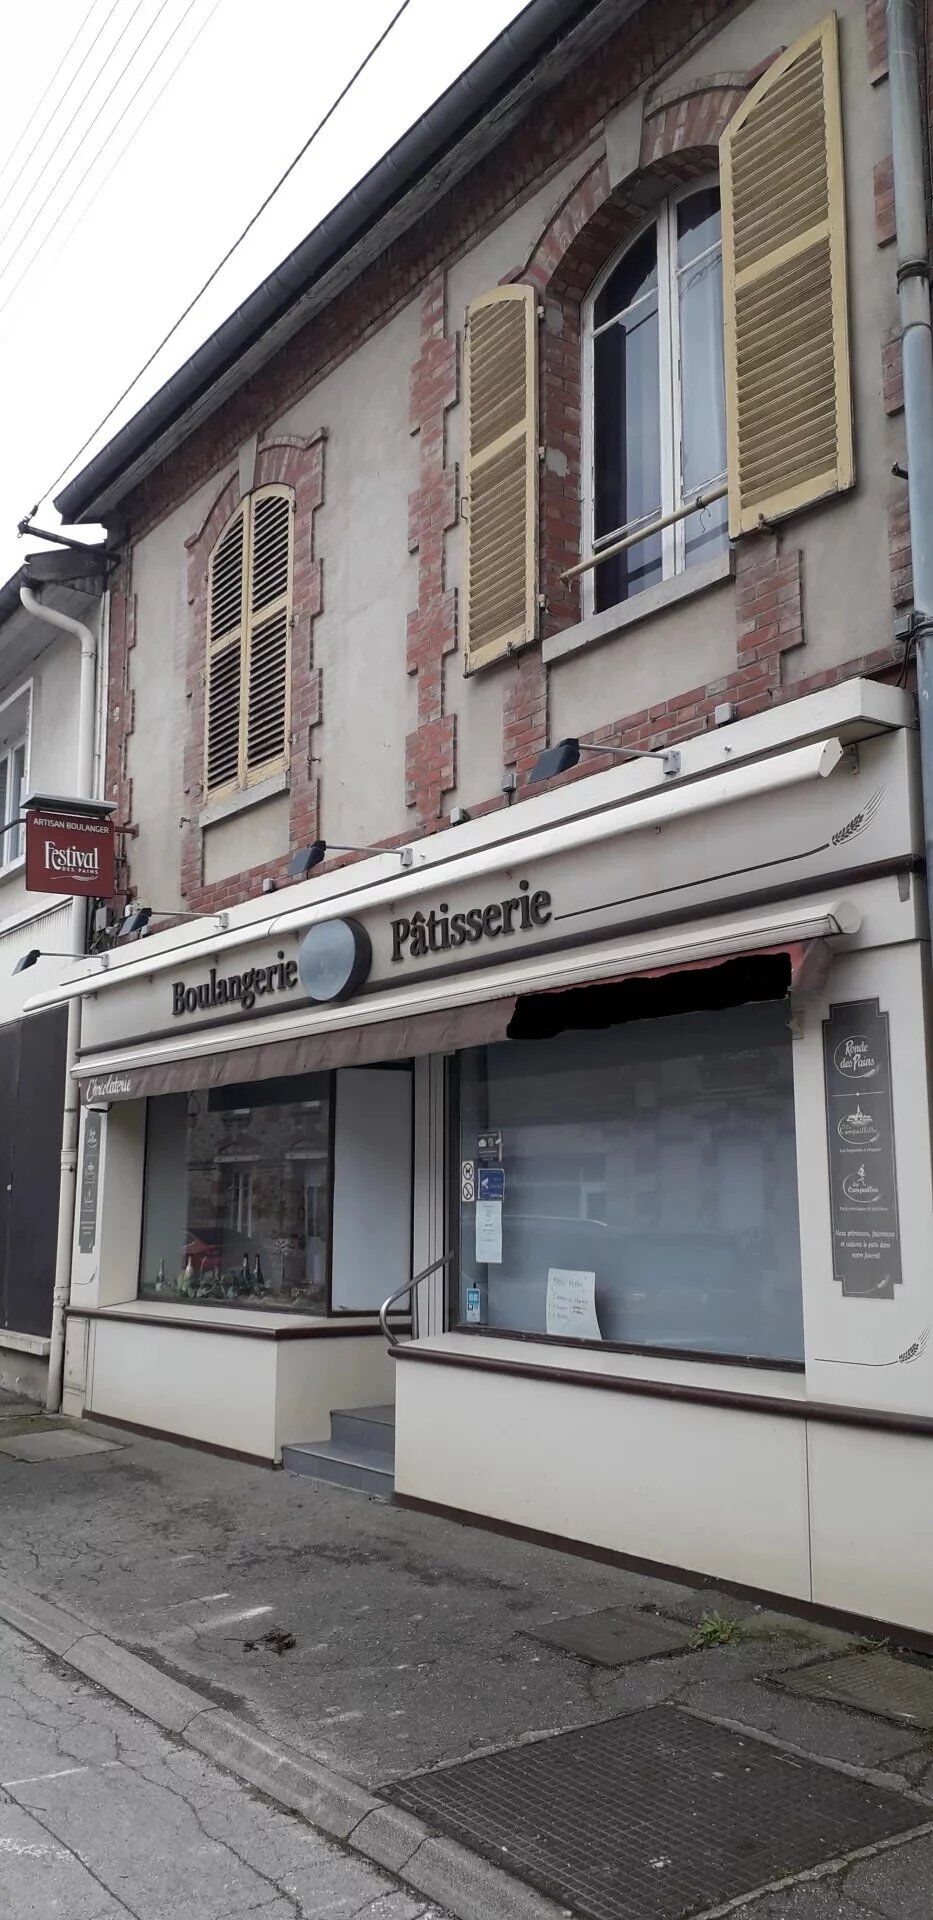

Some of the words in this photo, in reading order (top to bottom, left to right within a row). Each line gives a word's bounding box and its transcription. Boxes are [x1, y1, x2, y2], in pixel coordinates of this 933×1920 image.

[33, 818, 65, 830] ARTISAN
[66, 821, 109, 834] BOULANGER
[44, 840, 99, 871] Festival
[171, 950, 298, 1017] Boulangerie
[390, 879, 552, 962] Pâtisserie
[845, 1039, 869, 1057] Ronde
[840, 1057, 852, 1069] des
[853, 1053, 875, 1071] Pains
[86, 1073, 131, 1102] Chocolaterie
